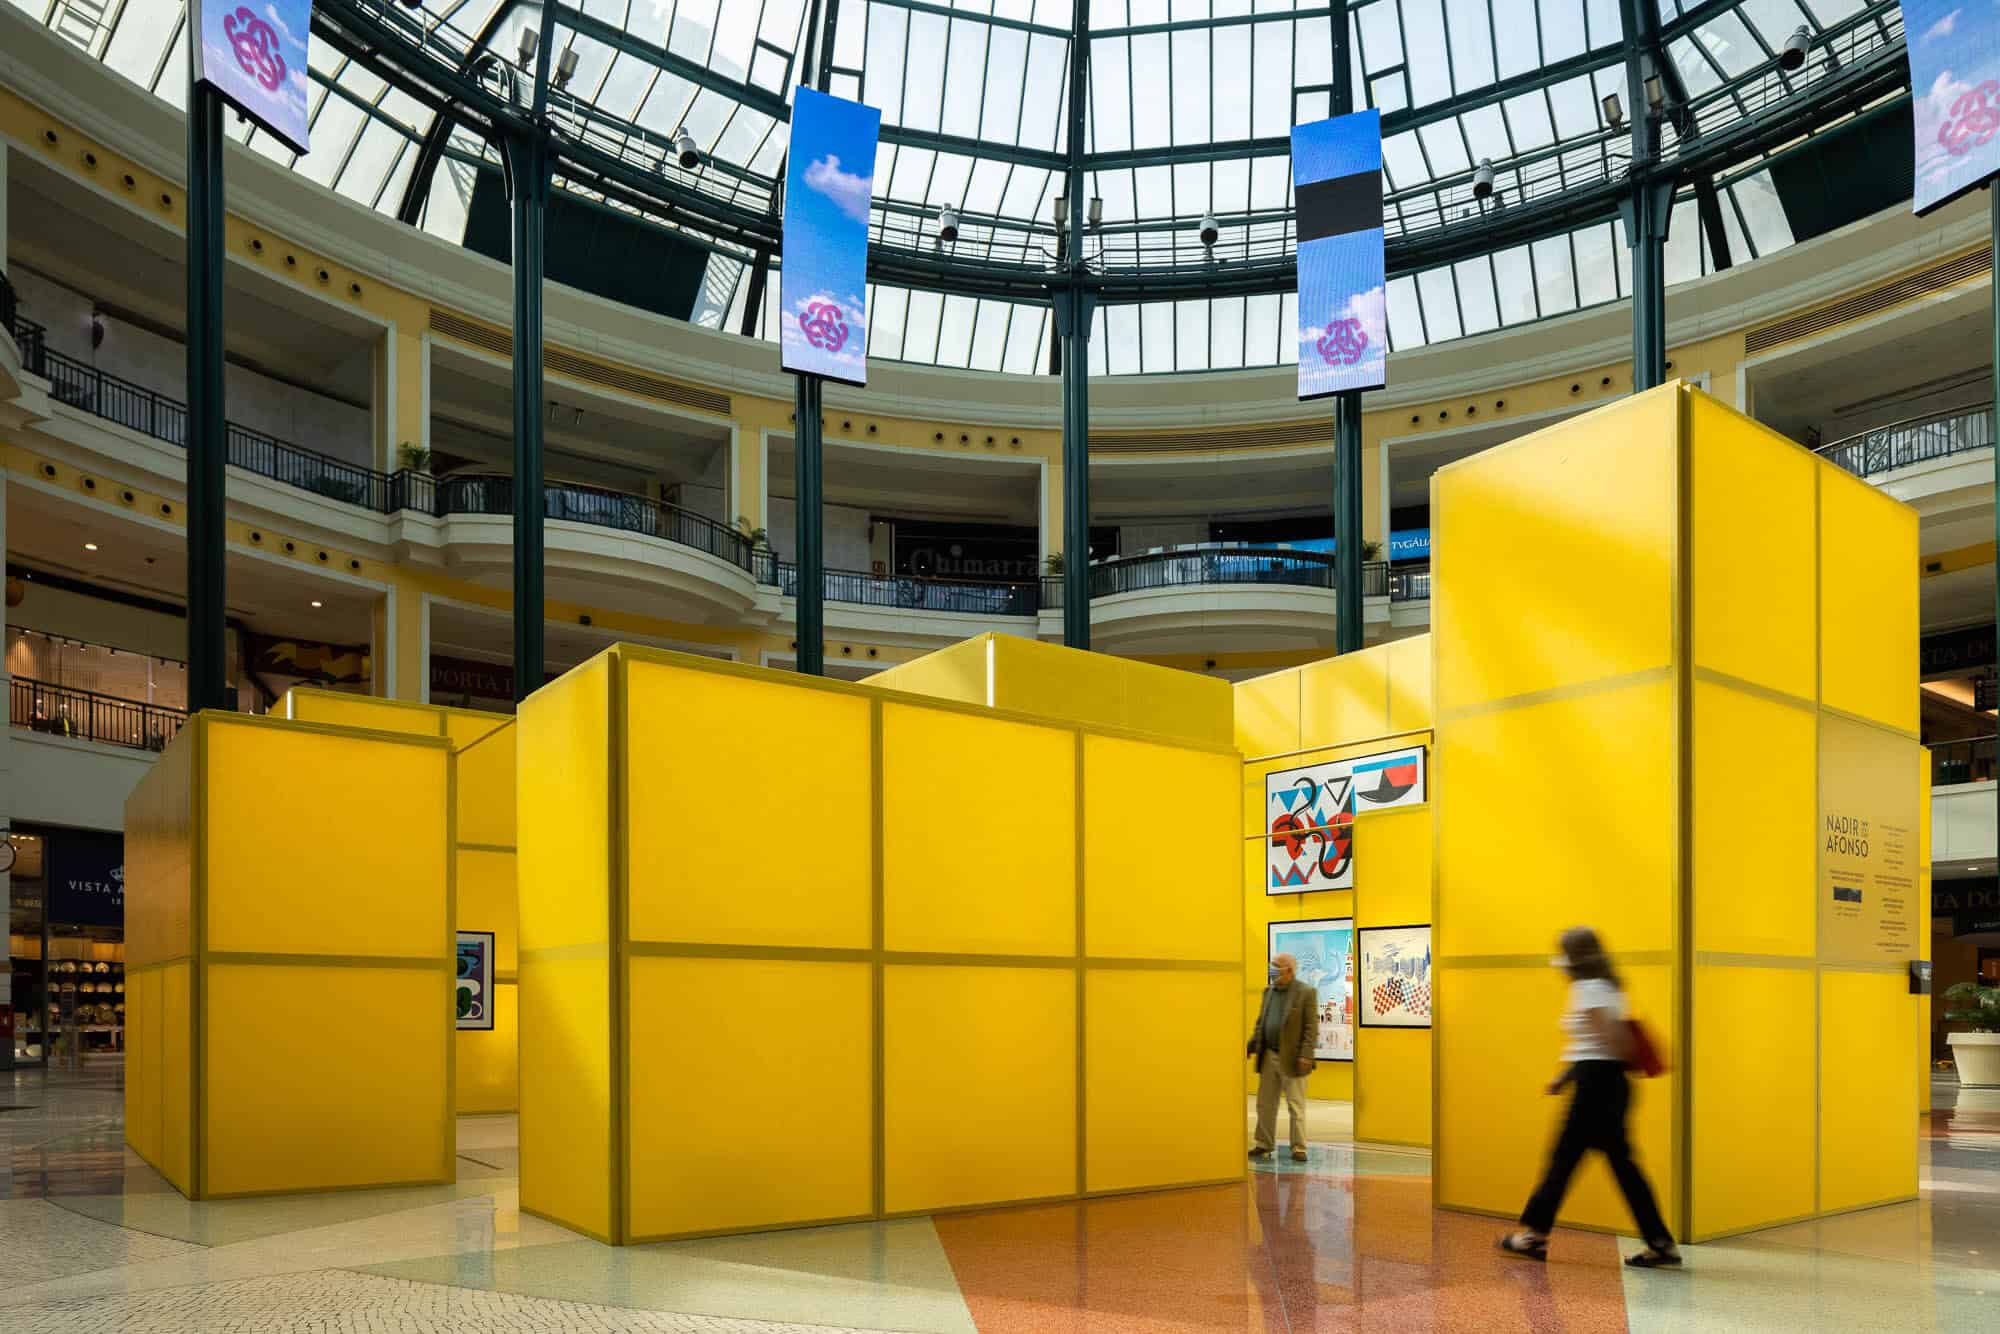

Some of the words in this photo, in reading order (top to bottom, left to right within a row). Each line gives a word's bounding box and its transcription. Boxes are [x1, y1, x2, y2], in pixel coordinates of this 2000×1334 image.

[1826, 815, 1859, 836] NADIR
[1826, 835, 1869, 858] AFONSO
[68, 880, 111, 894] VISTA
